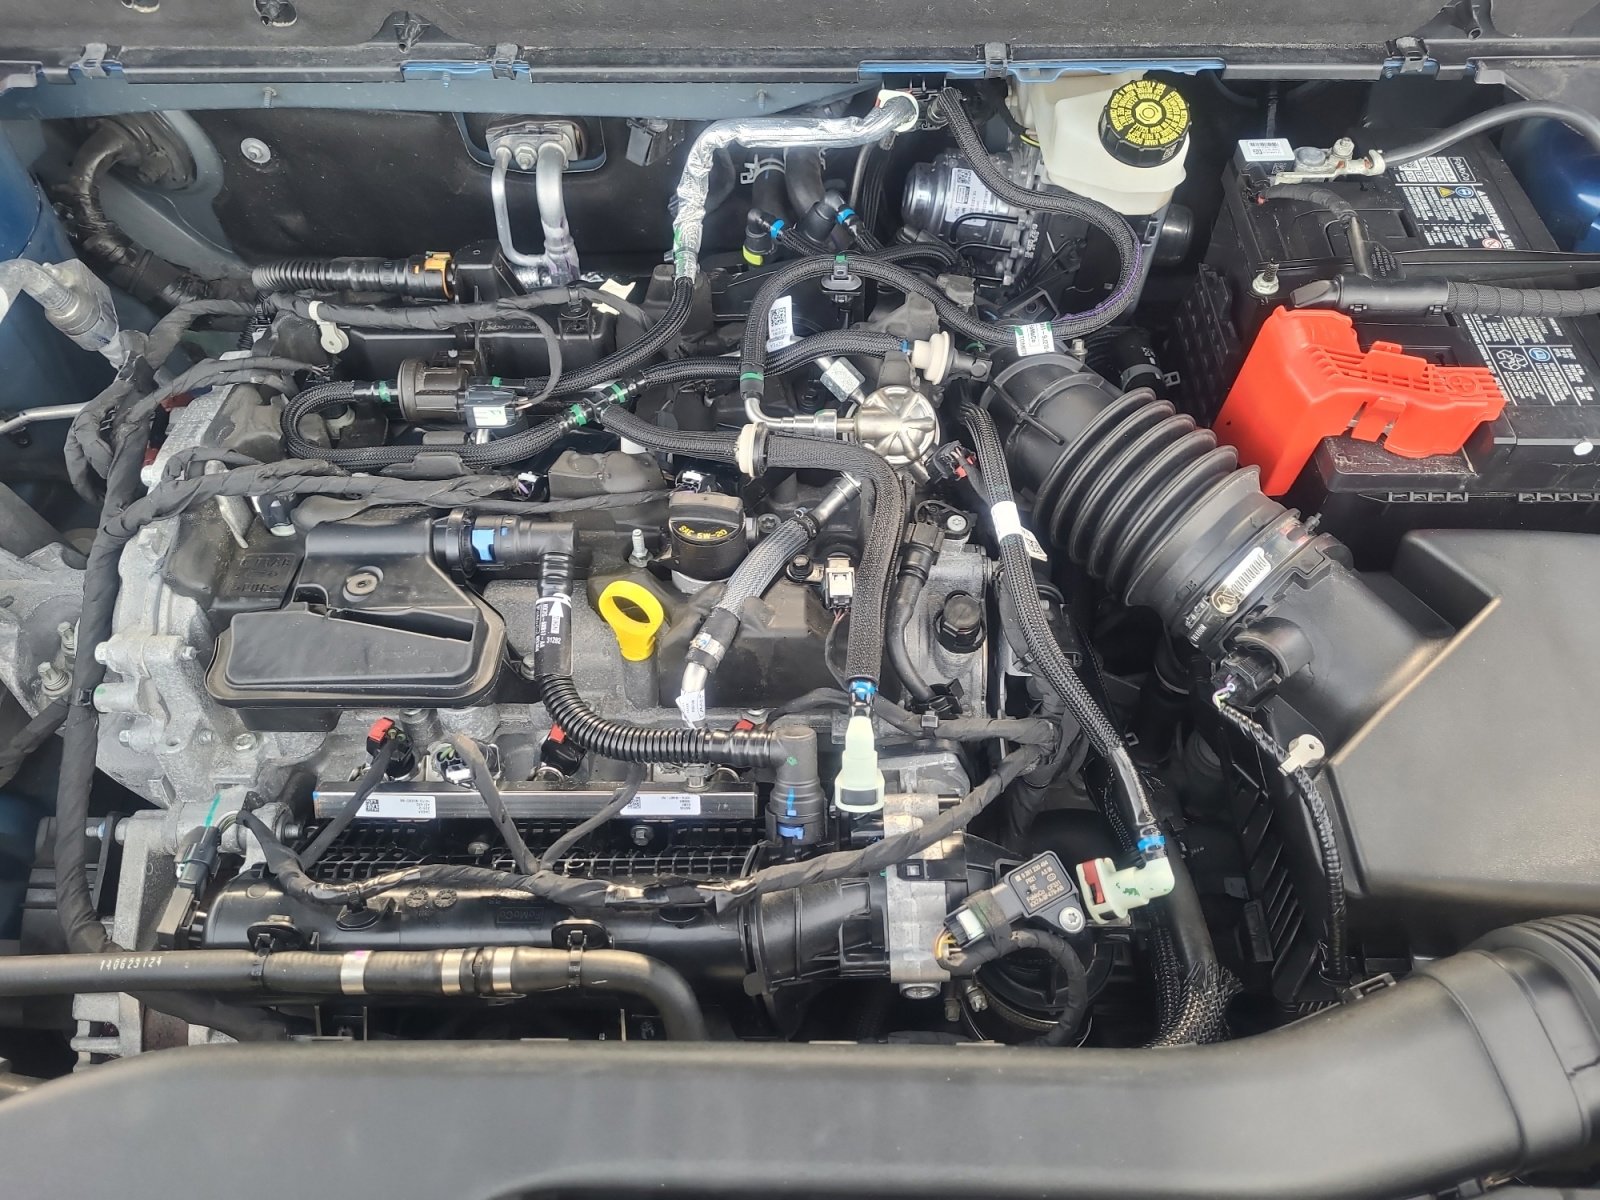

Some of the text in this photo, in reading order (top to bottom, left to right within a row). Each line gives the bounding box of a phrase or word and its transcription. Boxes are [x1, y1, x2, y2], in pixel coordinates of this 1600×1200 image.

[1454, 158, 1470, 181] FoMoCo
[678, 525, 728, 539] SAE 5W-20
